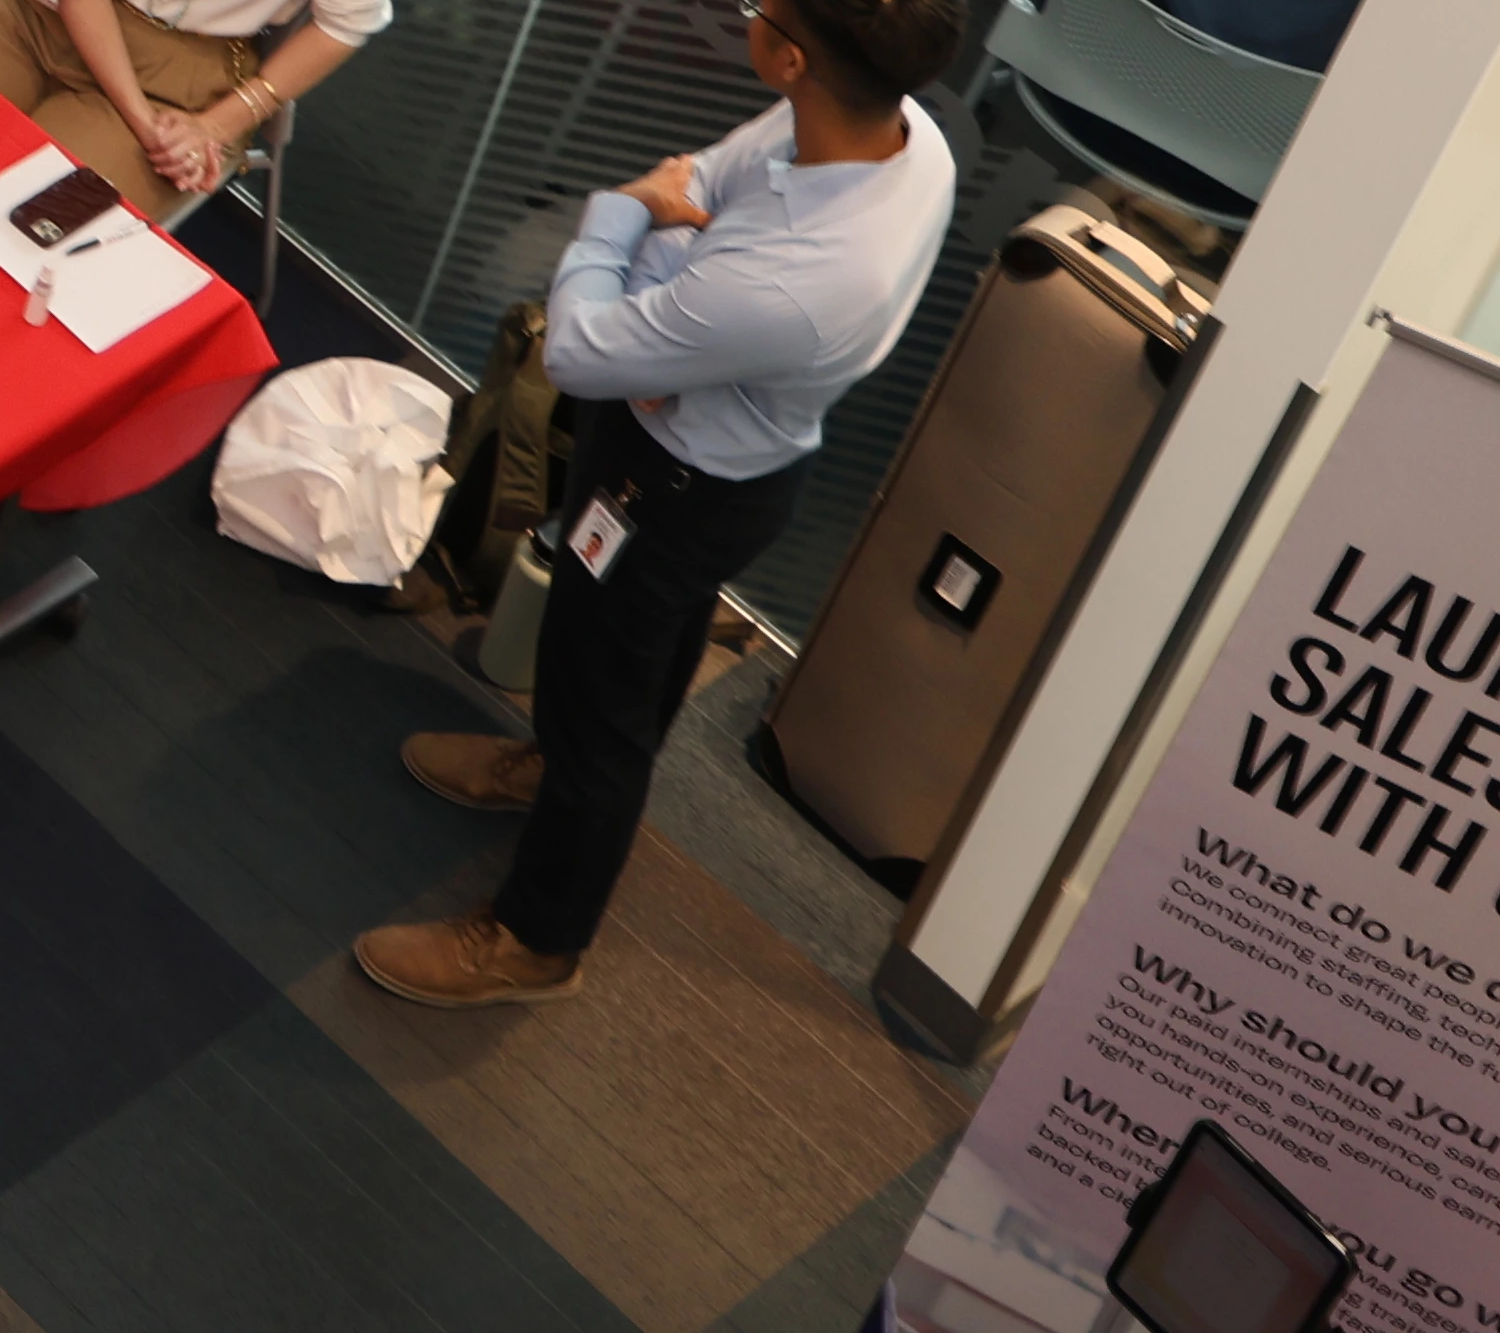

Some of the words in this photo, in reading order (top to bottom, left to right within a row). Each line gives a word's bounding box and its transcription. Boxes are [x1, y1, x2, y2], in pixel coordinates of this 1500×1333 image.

[1311, 543, 1500, 703] LAU
[1231, 711, 1488, 894] WITH
[1157, 895, 1300, 980] innovation
[1303, 972, 1334, 997] to
[1338, 991, 1422, 1041] shape
[1428, 1035, 1474, 1067] the
[1169, 877, 1317, 966] Combining
[1320, 956, 1430, 1023] staffing,
[1182, 854, 1225, 889] We
[1228, 883, 1342, 950] connect
[1344, 945, 1421, 988] great
[1197, 825, 1323, 911] What
[1328, 904, 1392, 944] do
[1403, 935, 1476, 985] we
[1086, 1032, 1148, 1075] right
[1150, 1069, 1196, 1101] out
[1199, 1094, 1232, 1117] of
[1233, 1110, 1332, 1173] college.
[1095, 1013, 1276, 1119] opportunities,
[1281, 1113, 1336, 1147] and
[1337, 1140, 1437, 1201] serious
[1103, 992, 1156, 1029] you
[1160, 1023, 1285, 1097] hands-on
[1289, 1090, 1444, 1181] experience,
[1118, 973, 1167, 1007] Our
[1169, 1004, 1229, 1041] paid
[1233, 1034, 1382, 1121] internships
[1387, 1117, 1441, 1150] and
[1443, 1144, 1500, 1183] sale
[1133, 942, 1236, 1015] Why
[1240, 1009, 1405, 1103] should
[1404, 1093, 1500, 1155] you
[1026, 1144, 1076, 1177] and
[1078, 1174, 1094, 1188] a
[1099, 1184, 1136, 1210] cle
[1037, 1123, 1131, 1183] backed
[1048, 1103, 1115, 1151] From
[1120, 1145, 1167, 1179] inte
[1400, 1267, 1464, 1308] go
